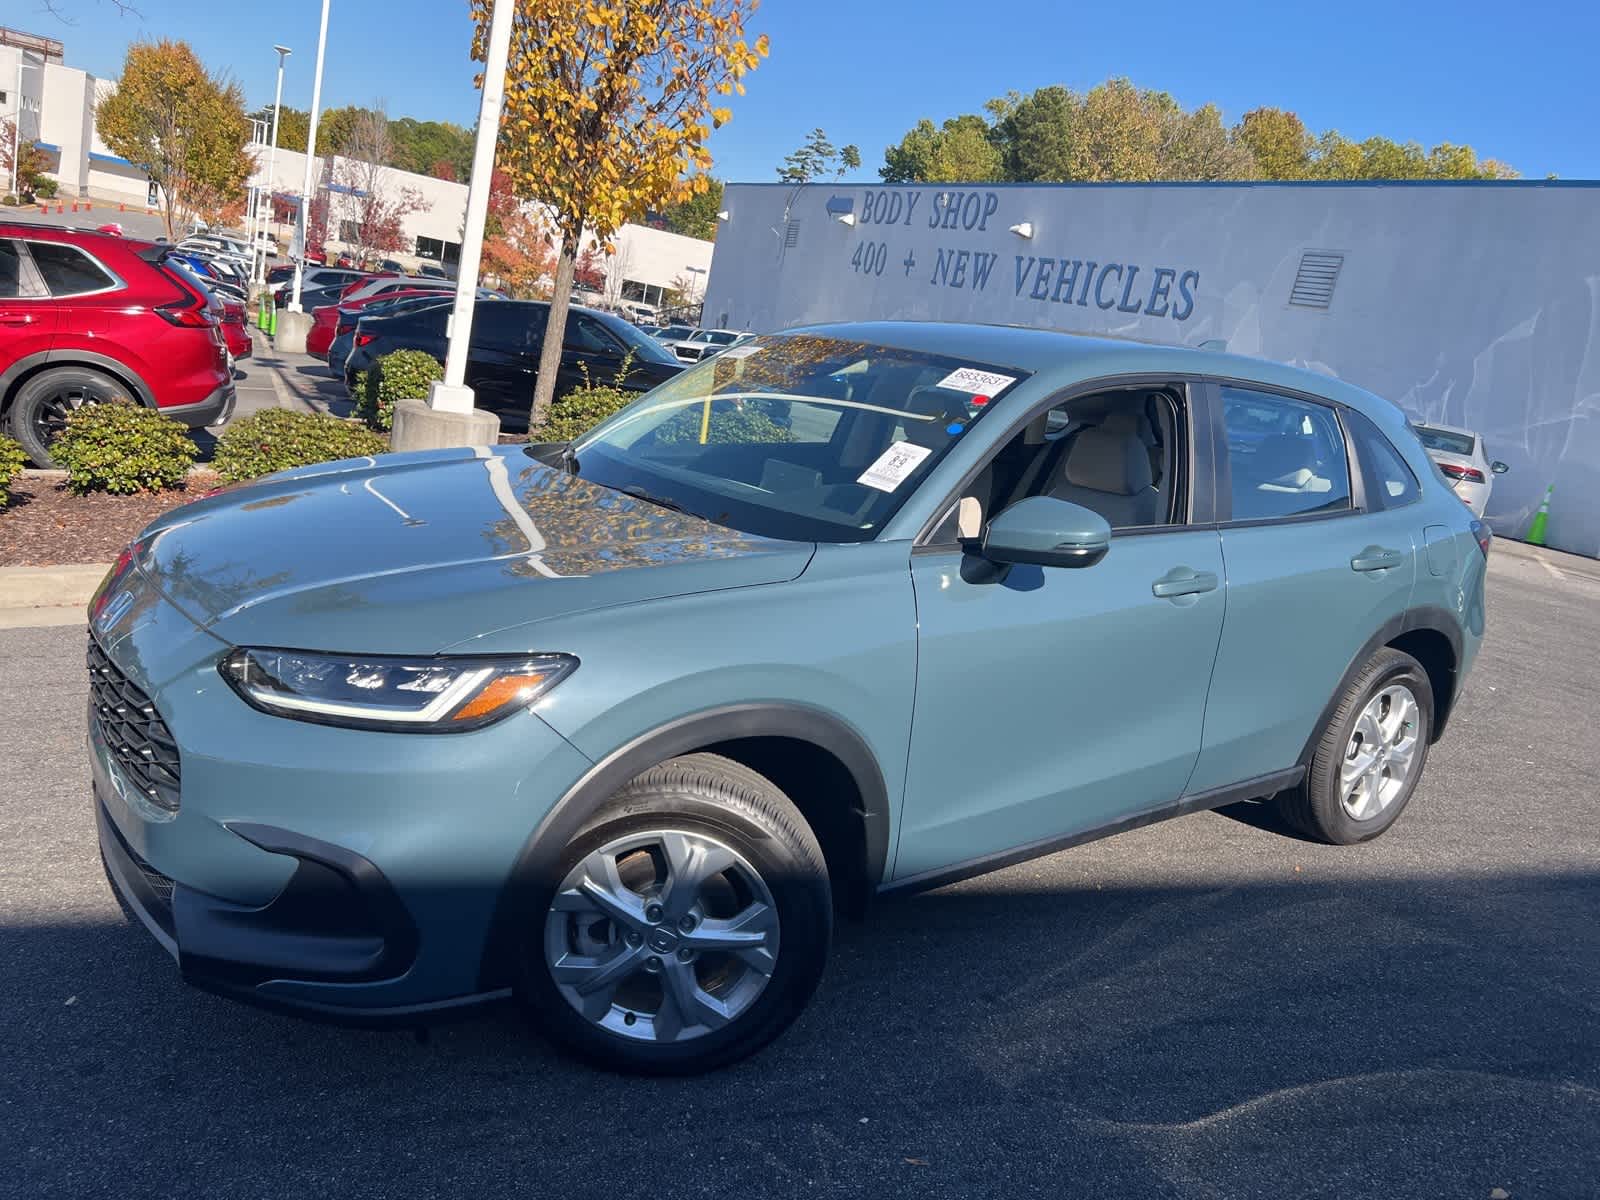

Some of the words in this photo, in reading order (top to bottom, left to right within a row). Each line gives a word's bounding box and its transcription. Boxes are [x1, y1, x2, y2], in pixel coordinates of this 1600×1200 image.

[860, 190, 921, 226] BODY
[929, 191, 999, 231] SHOP
[851, 240, 888, 277] 400
[903, 249, 916, 277] +
[930, 247, 998, 291] NEW
[1015, 255, 1200, 321] VEHICLES
